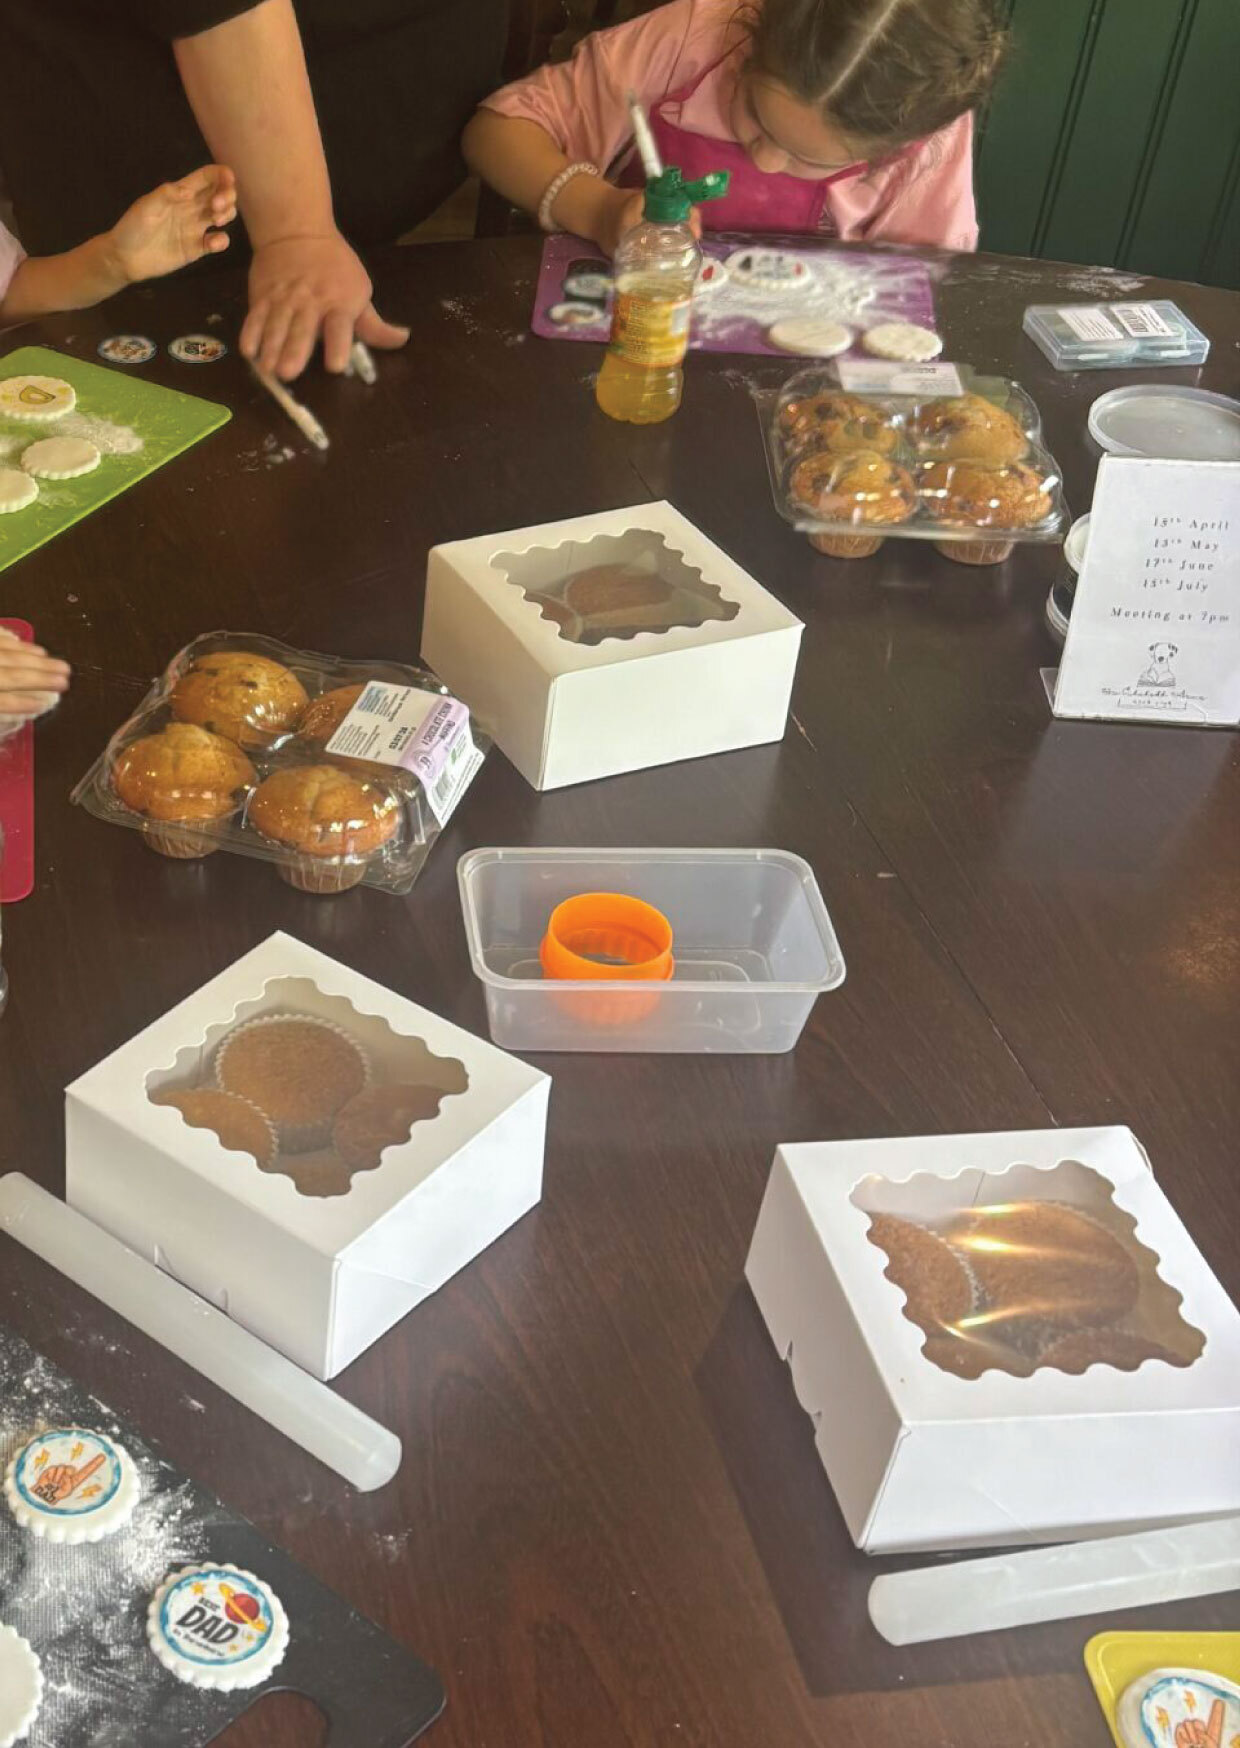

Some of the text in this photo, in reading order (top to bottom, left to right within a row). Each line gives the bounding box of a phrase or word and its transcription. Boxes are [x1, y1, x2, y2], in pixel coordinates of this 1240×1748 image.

[1189, 519, 1228, 532] April
[1191, 539, 1219, 553] May
[1179, 559, 1214, 571] June
[1176, 579, 1209, 592] July
[1110, 606, 1229, 624] Meeting at 7pm
[175, 1604, 239, 1644] DAD
